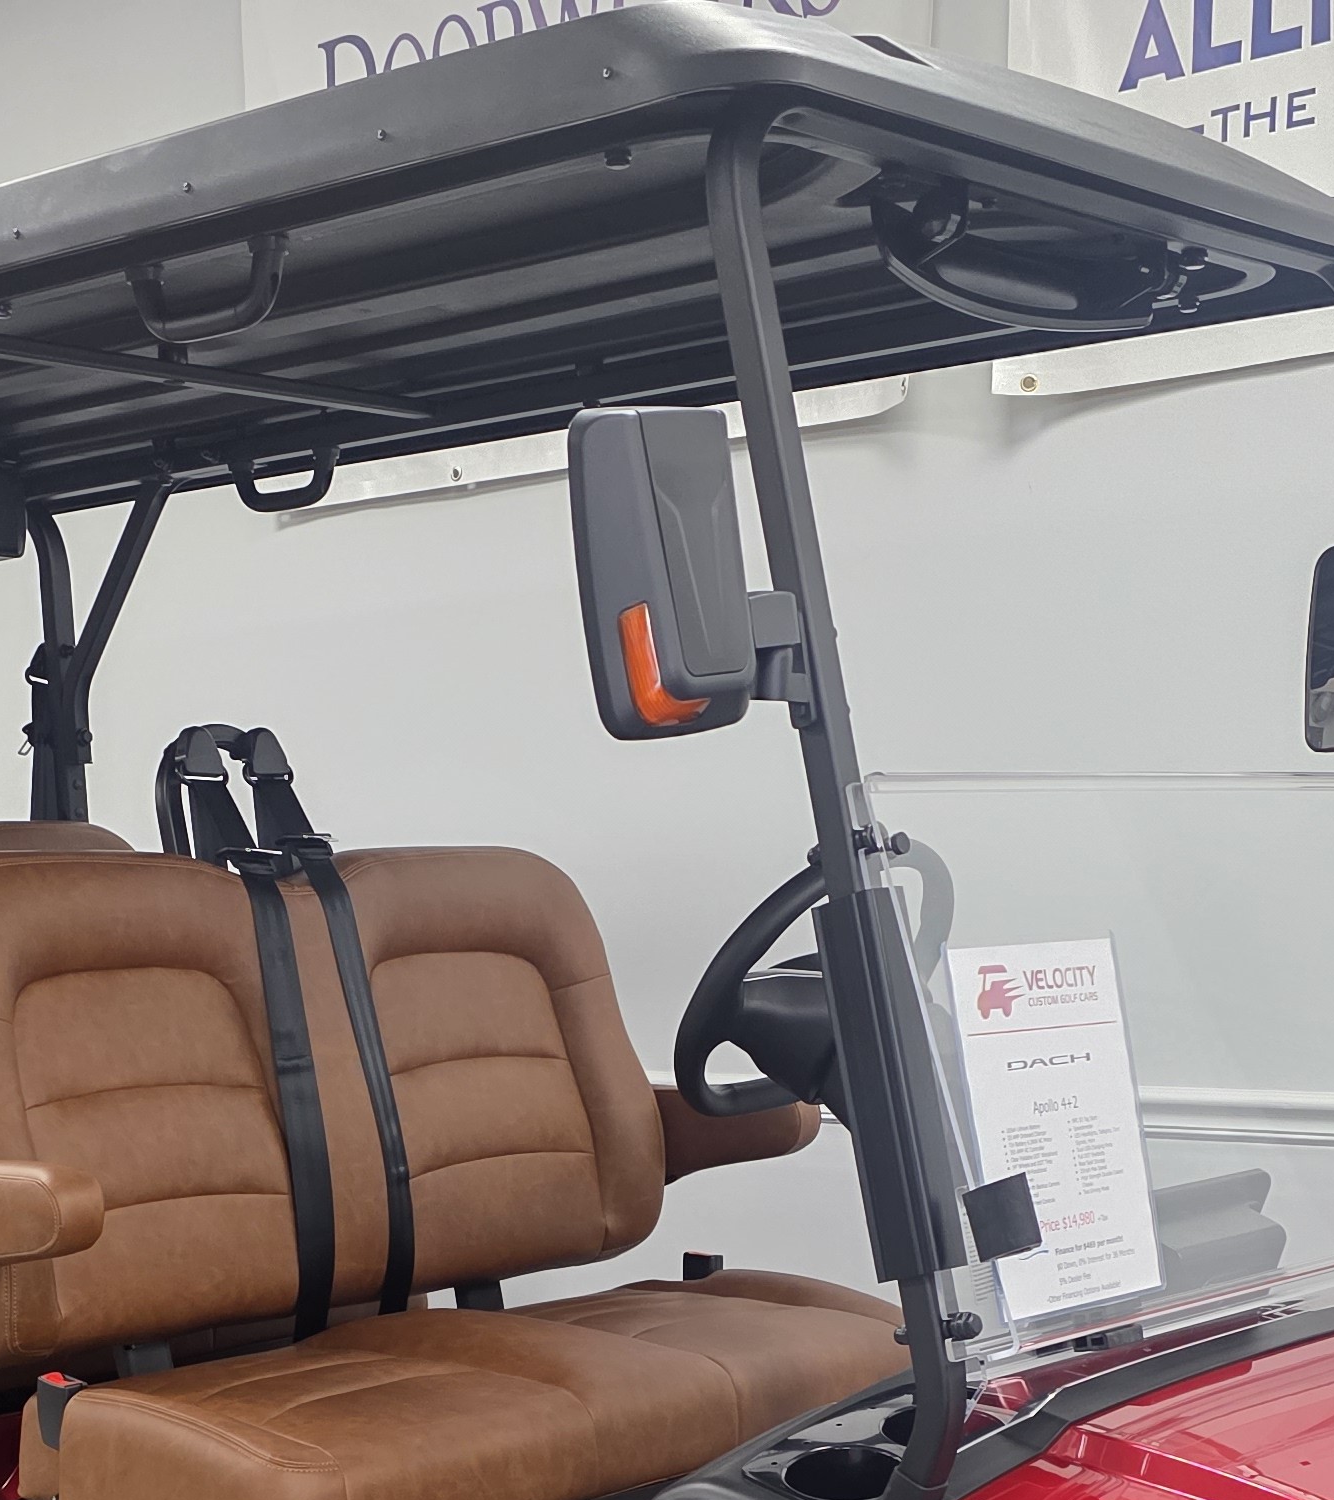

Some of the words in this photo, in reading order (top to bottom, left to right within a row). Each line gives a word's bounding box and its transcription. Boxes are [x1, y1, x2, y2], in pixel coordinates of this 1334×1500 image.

[1210, 87, 1316, 143] THE
[1022, 965, 1096, 991] VELOCITY
[1027, 994, 1059, 1007] CUSTOM
[1059, 993, 1078, 1004] GOLF
[1078, 991, 1099, 1002] CARS
[1007, 1052, 1091, 1071] DACH
[1033, 1098, 1059, 1116] Apollo
[1061, 1095, 1079, 1110] 4+2
[1039, 1219, 1061, 1233] Price
